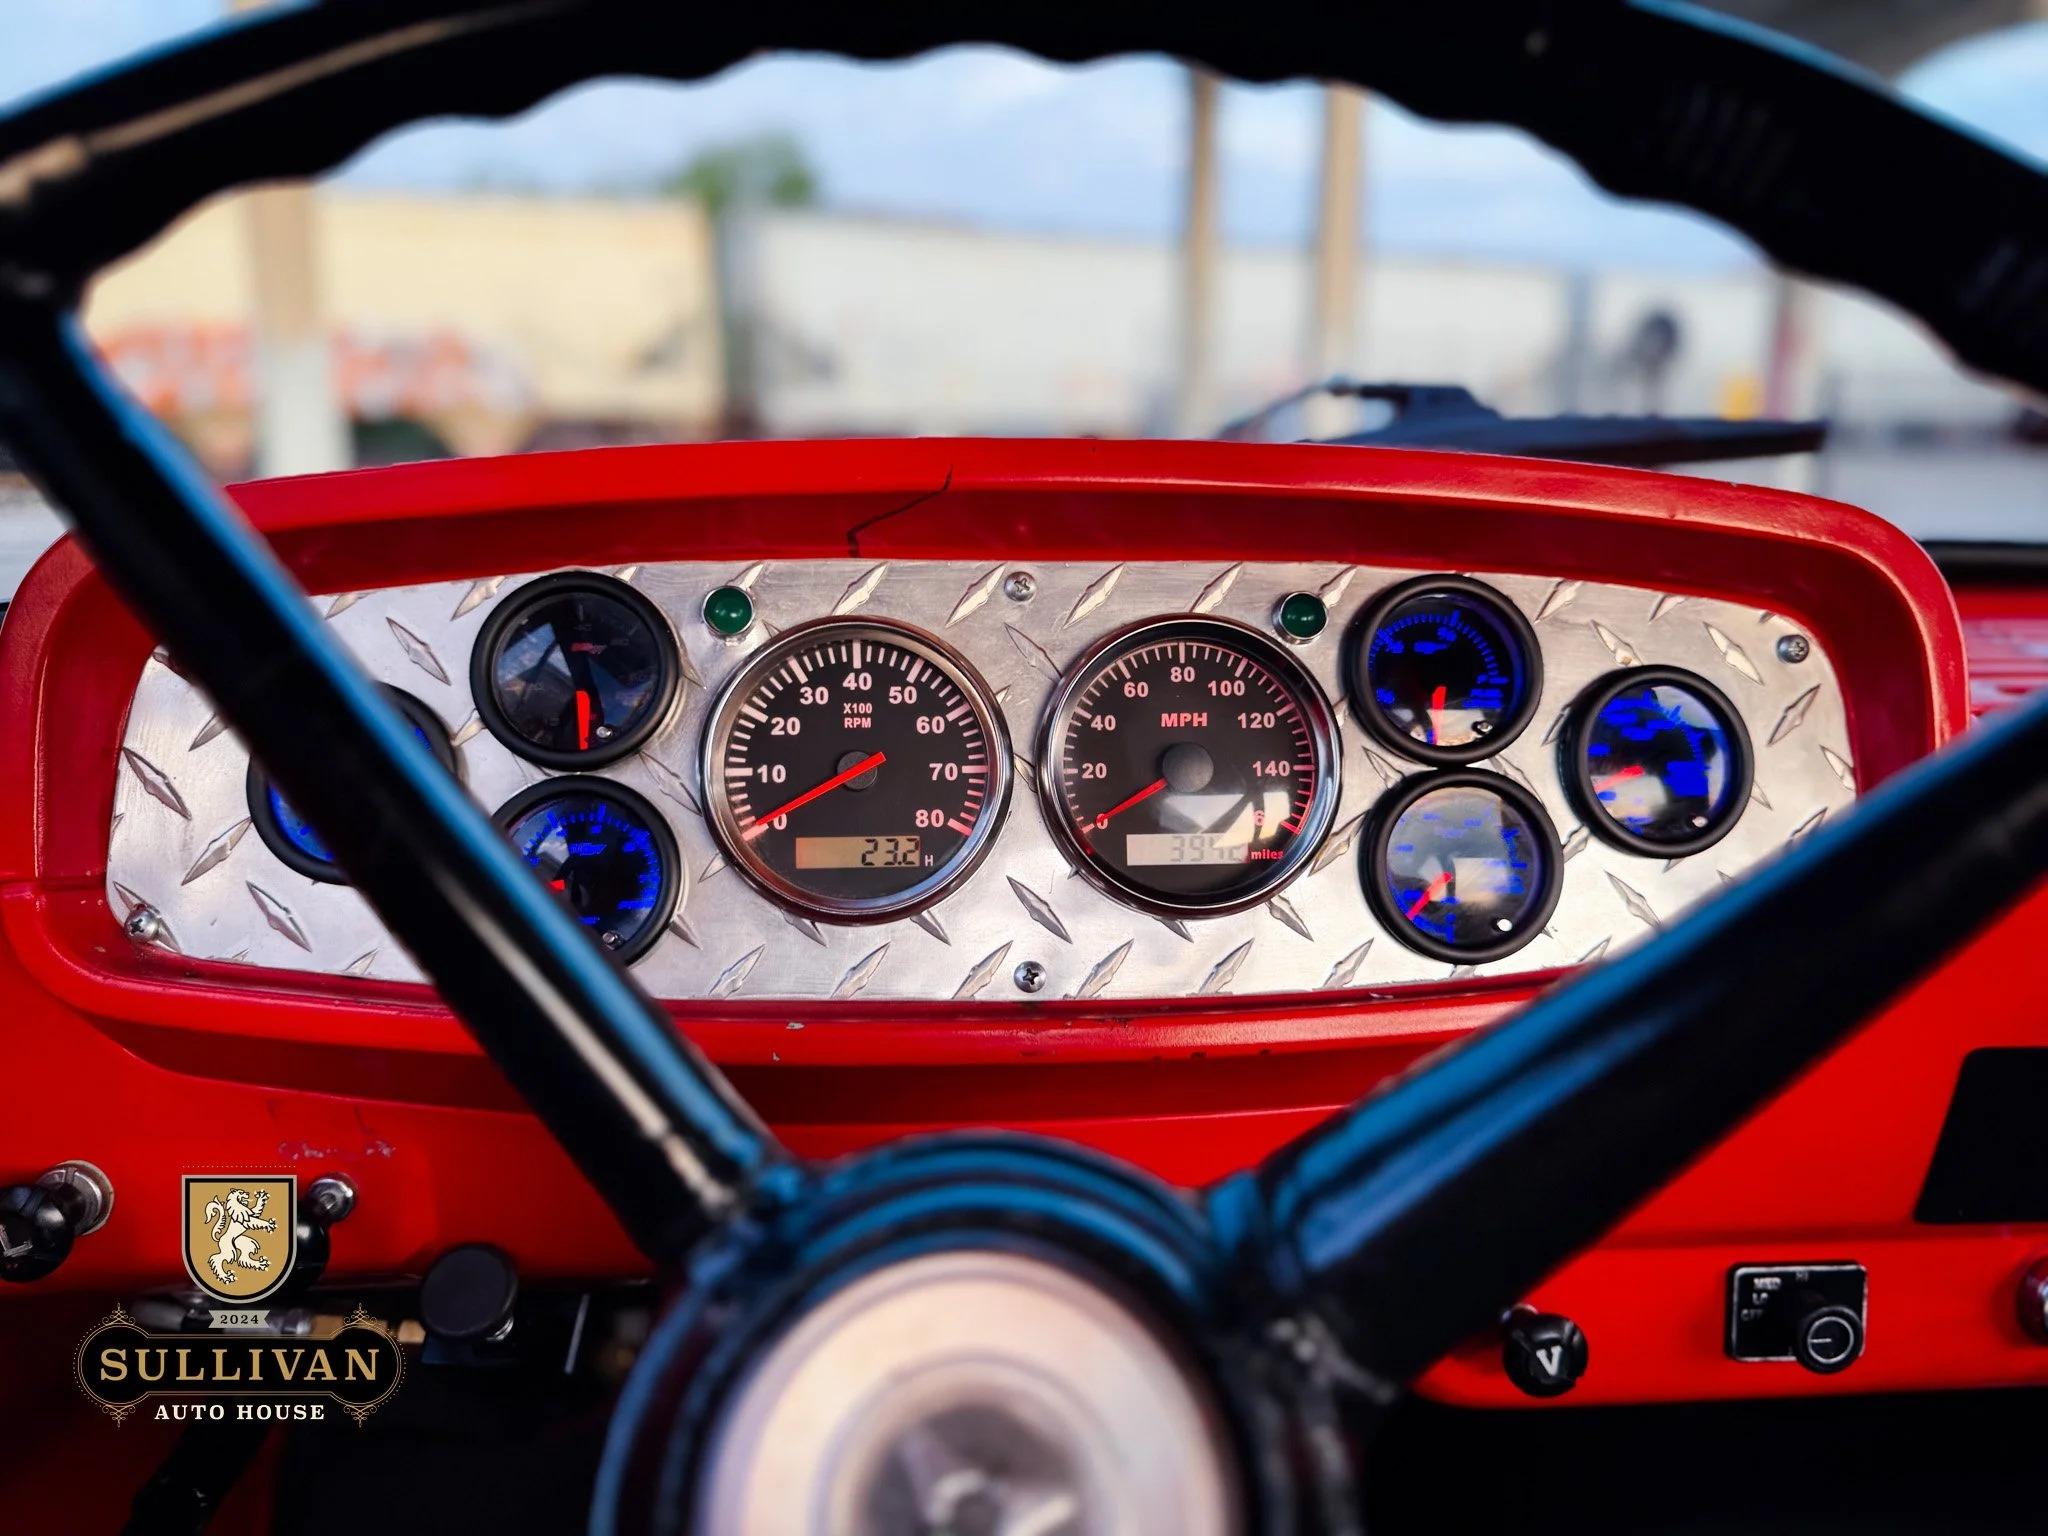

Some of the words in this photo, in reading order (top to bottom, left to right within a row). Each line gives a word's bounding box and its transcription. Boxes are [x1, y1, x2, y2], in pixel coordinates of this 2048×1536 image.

[843, 672, 872, 690] 40
[1170, 667, 1195, 682] 80
[800, 686, 829, 705] 30
[889, 686, 918, 704] 50
[1124, 682, 1149, 698] 60
[1208, 680, 1245, 696] 100
[843, 703, 872, 714] X100
[771, 717, 800, 735] 20
[844, 717, 871, 729] RPM
[916, 716, 945, 734] 60
[1091, 715, 1116, 731] 40
[1161, 712, 1208, 727] MPH
[1238, 712, 1275, 728] 120
[757, 765, 786, 783] 10
[929, 763, 958, 781] 70
[1082, 763, 1107, 778] 20
[1252, 761, 1290, 777] 140
[773, 813, 787, 830] 0
[915, 809, 944, 827] 80
[1096, 814, 1108, 829] 0
[861, 838, 920, 866] 23.2
[924, 855, 934, 867] H
[1251, 848, 1283, 860] miles
[1536, 1345, 1562, 1376] V
